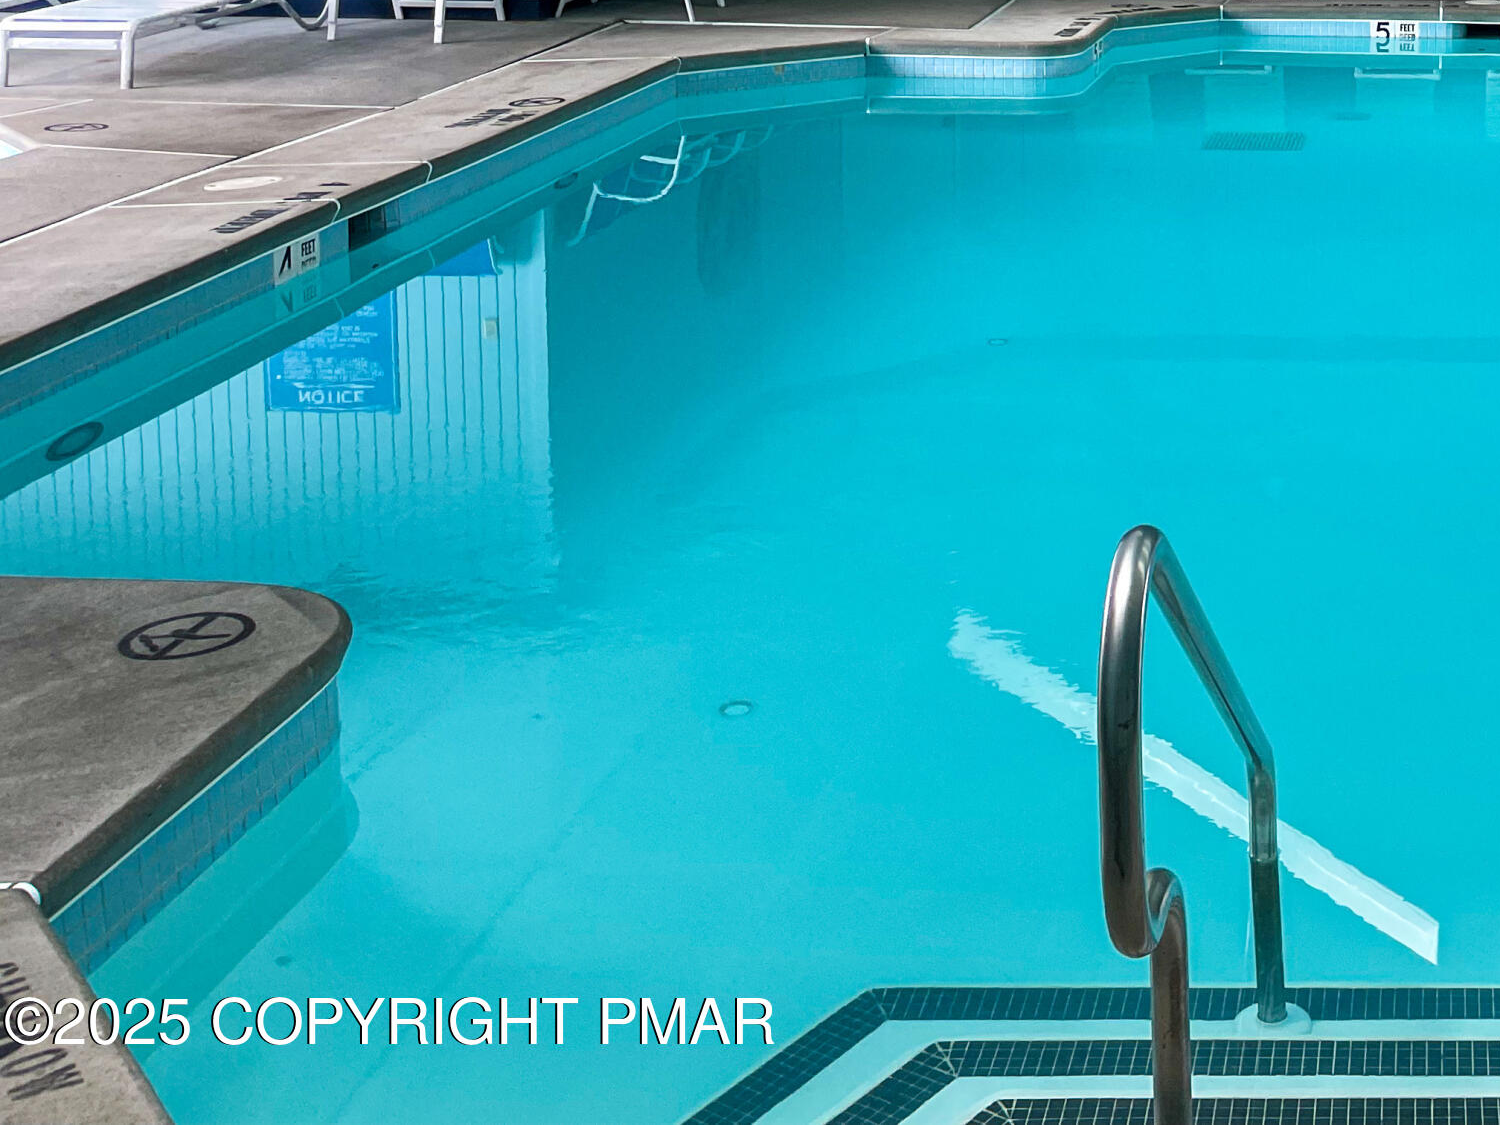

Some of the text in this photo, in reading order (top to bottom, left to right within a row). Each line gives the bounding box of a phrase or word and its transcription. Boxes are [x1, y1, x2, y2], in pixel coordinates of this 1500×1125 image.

[1376, 21, 1390, 38] 5
[1400, 24, 1415, 32] FEET
[301, 238, 315, 257] FEET
